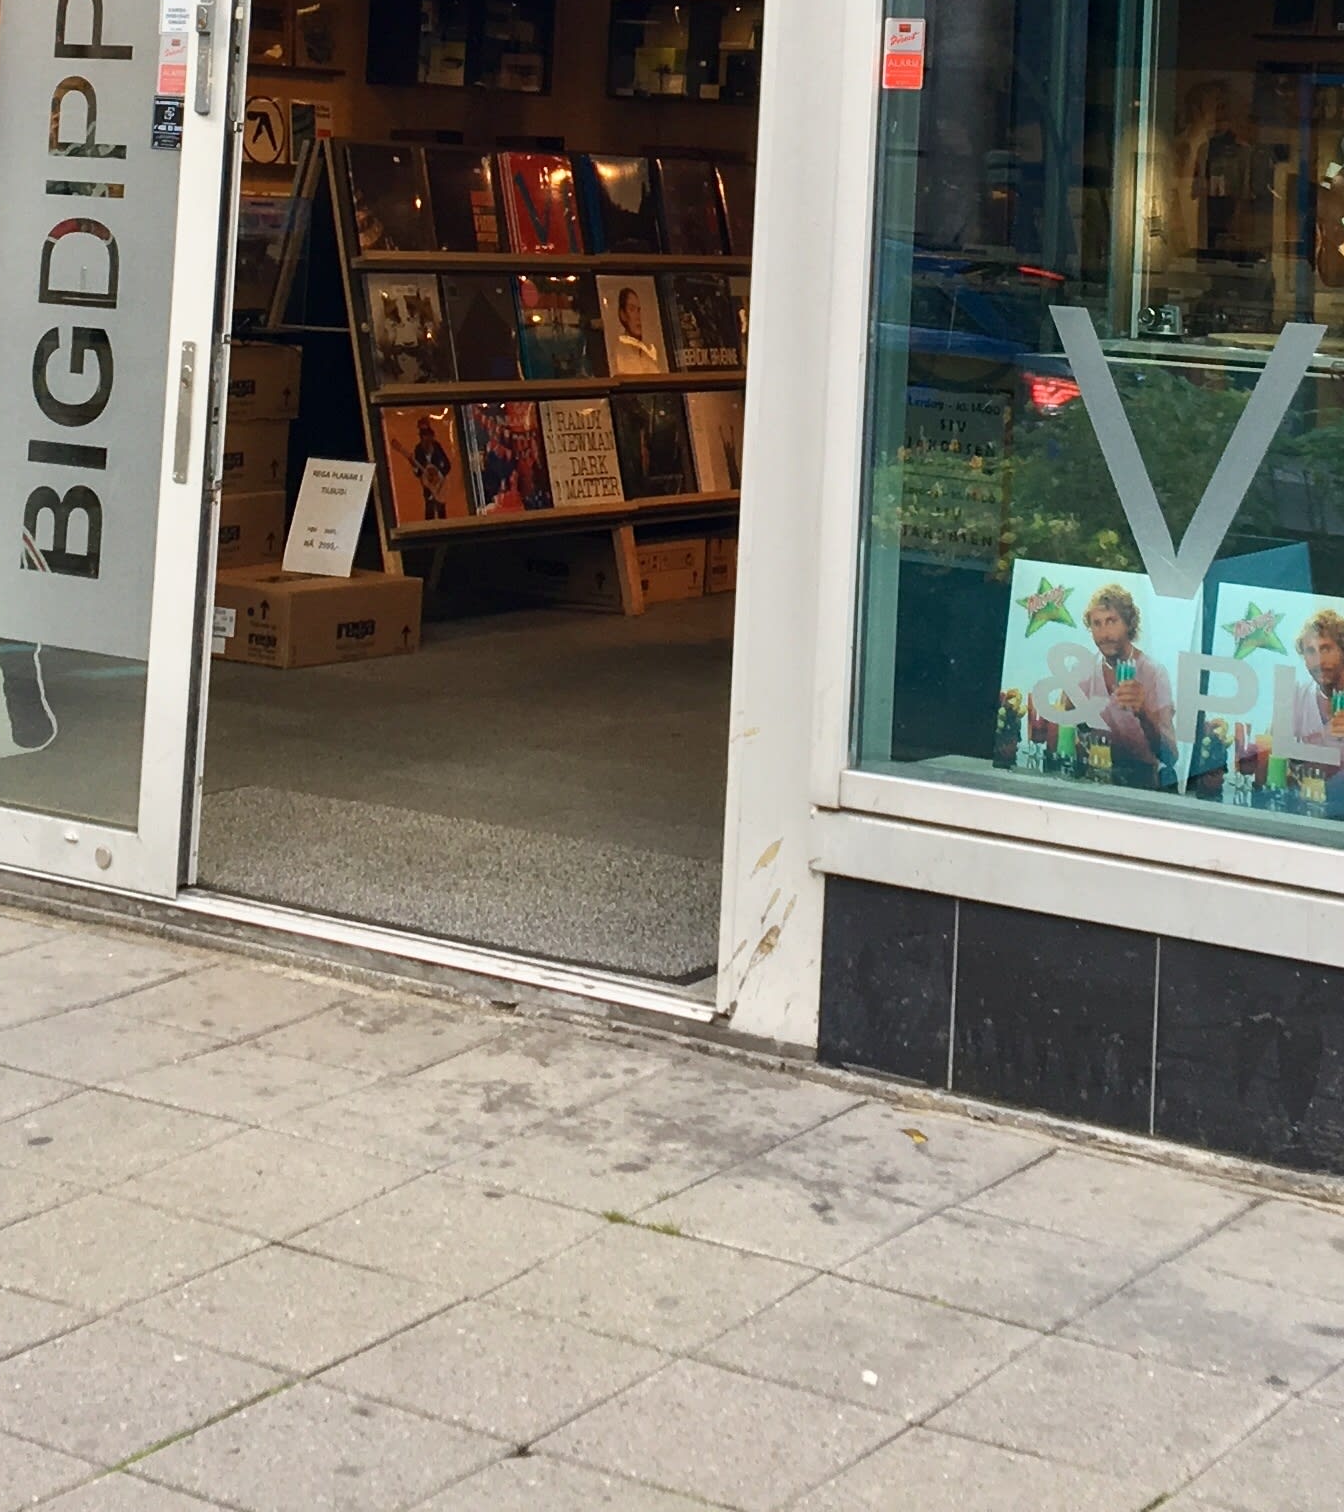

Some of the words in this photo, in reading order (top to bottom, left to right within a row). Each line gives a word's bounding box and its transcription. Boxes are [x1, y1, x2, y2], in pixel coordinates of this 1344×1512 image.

[555, 409, 602, 431] RANDY
[557, 431, 615, 453] NEWMAN
[569, 455, 609, 476] DARK
[564, 476, 620, 500] MATTER
[1032, 642, 1106, 731] &
